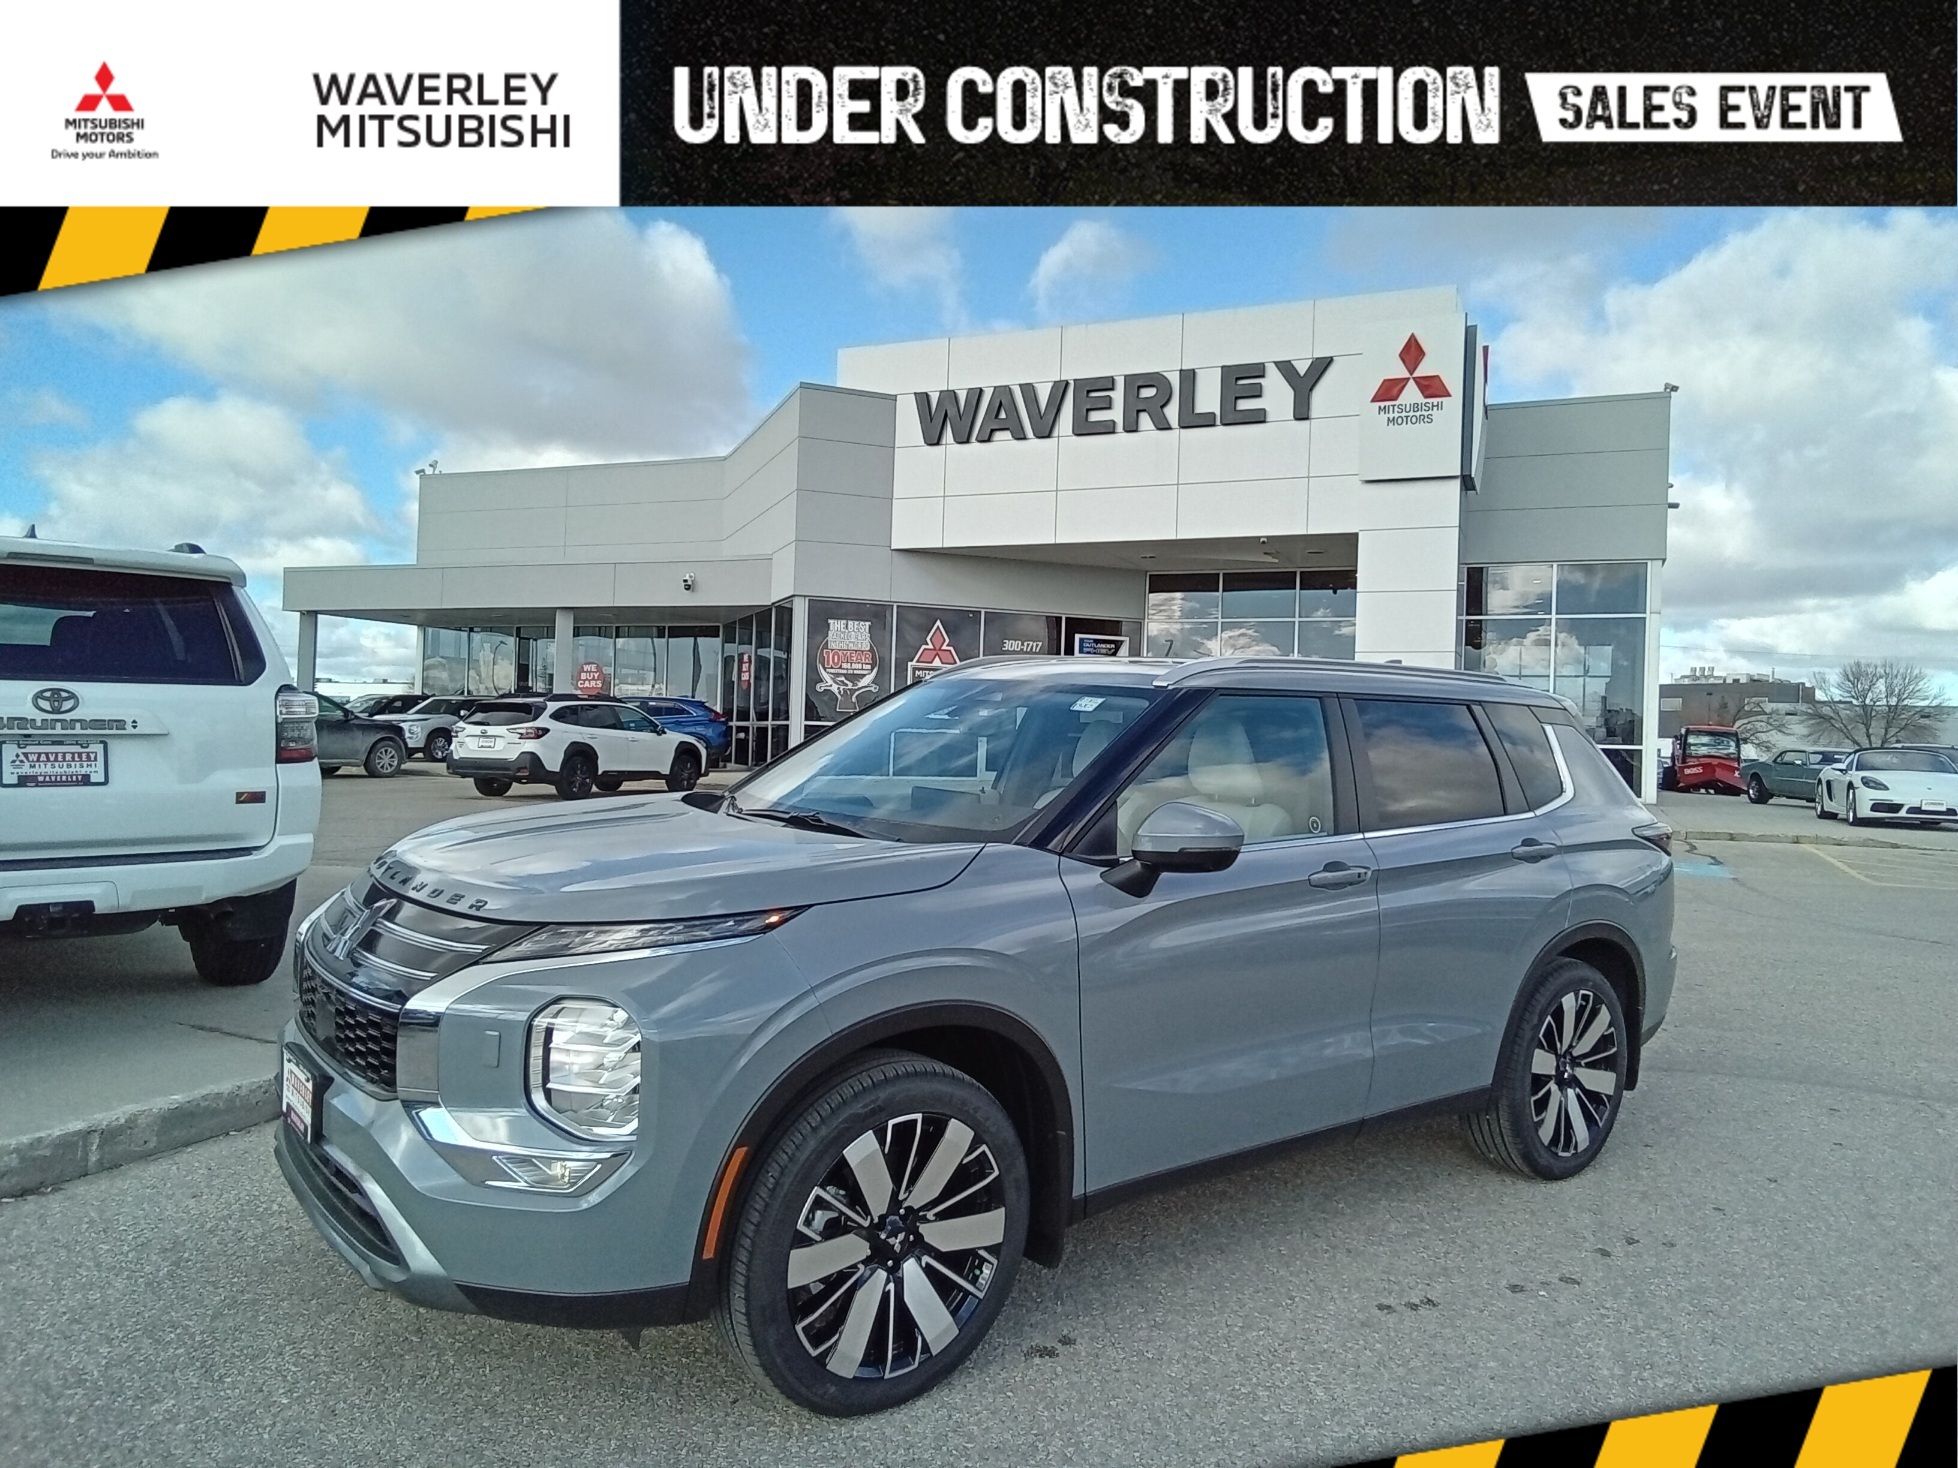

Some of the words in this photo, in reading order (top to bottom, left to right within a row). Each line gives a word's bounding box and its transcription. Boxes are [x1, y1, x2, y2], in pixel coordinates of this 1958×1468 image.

[913, 356, 1334, 446] WAVERLEY
[1377, 401, 1444, 415] MITSUBISHI
[1386, 413, 1434, 427] MOTORS
[828, 619, 847, 631] THE
[847, 620, 871, 633] BEST
[1001, 640, 1042, 652] 300-1717
[824, 649, 841, 668] 10
[841, 651, 873, 663] YEAR
[581, 672, 600, 680] BUY
[577, 680, 602, 688] CARS
[27, 752, 97, 761] WAVERLEY
